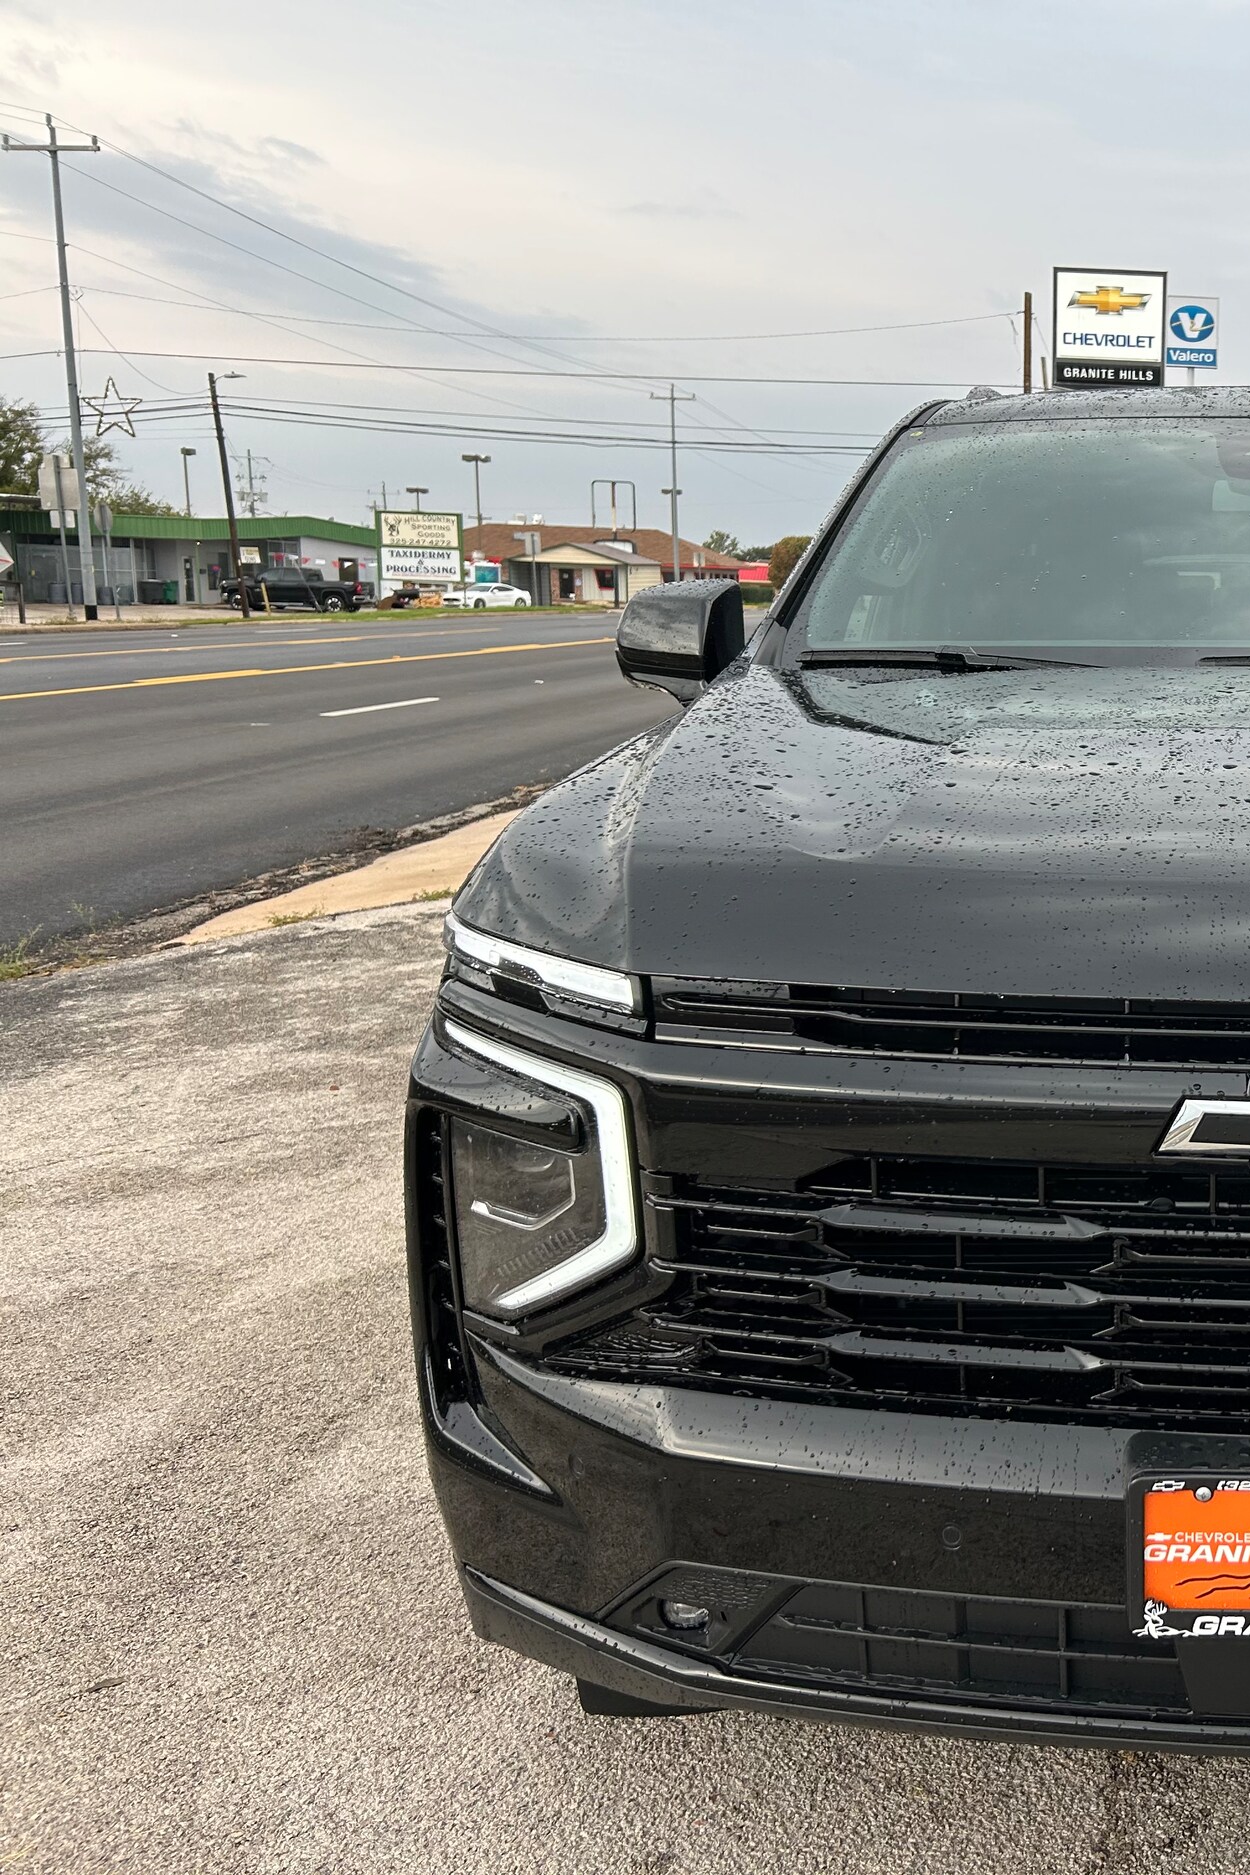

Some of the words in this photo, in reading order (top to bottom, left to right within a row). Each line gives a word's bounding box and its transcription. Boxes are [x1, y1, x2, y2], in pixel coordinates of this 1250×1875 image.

[1062, 331, 1156, 349] CHEVROLET
[1169, 350, 1214, 363] Valero
[1063, 367, 1115, 380] GRANITE
[1119, 369, 1154, 381] HILLS
[404, 515, 420, 524] HILL
[422, 514, 456, 526] COUNTRY
[411, 523, 451, 531] SPORTING
[417, 530, 446, 538] GOODS
[388, 549, 452, 559] TAXIDERMY
[386, 564, 457, 575] PROCESSING
